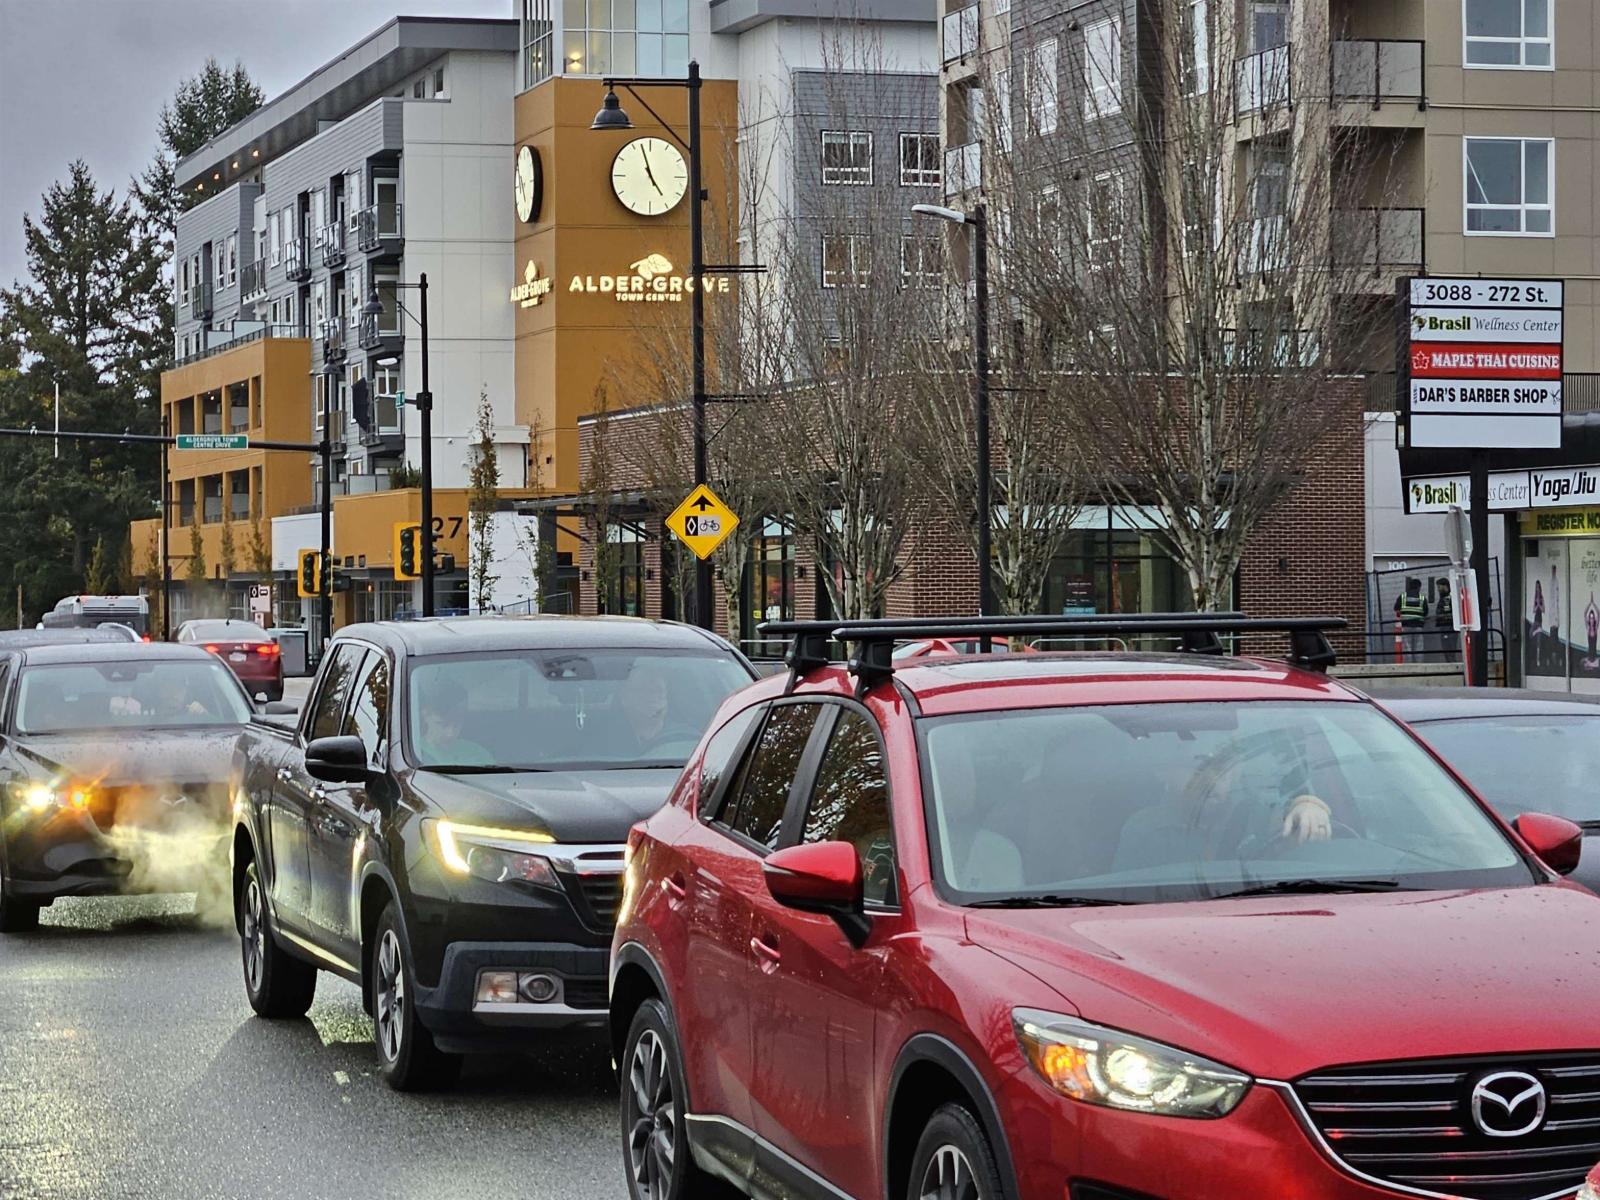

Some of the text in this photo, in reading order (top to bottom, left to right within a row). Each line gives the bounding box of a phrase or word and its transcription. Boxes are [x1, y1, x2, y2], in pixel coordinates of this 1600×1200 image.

[616, 293, 682, 302] TOWN CENTRE
[1426, 284, 1472, 300] 3088
[1488, 286, 1520, 302] 272
[1525, 287, 1548, 303] St.
[1428, 316, 1560, 332] Brasil Wellness Center
[1432, 353, 1560, 369] MAPLE THAI CUISINE
[1419, 387, 1548, 404] DAR'S BARBER SHOP
[1424, 482, 1457, 504] Brasil
[1498, 482, 1529, 501] Center
[1534, 471, 1596, 502] Yoga/Jiu
[1537, 512, 1585, 531] REGISTER
[1388, 561, 1408, 570] 100
